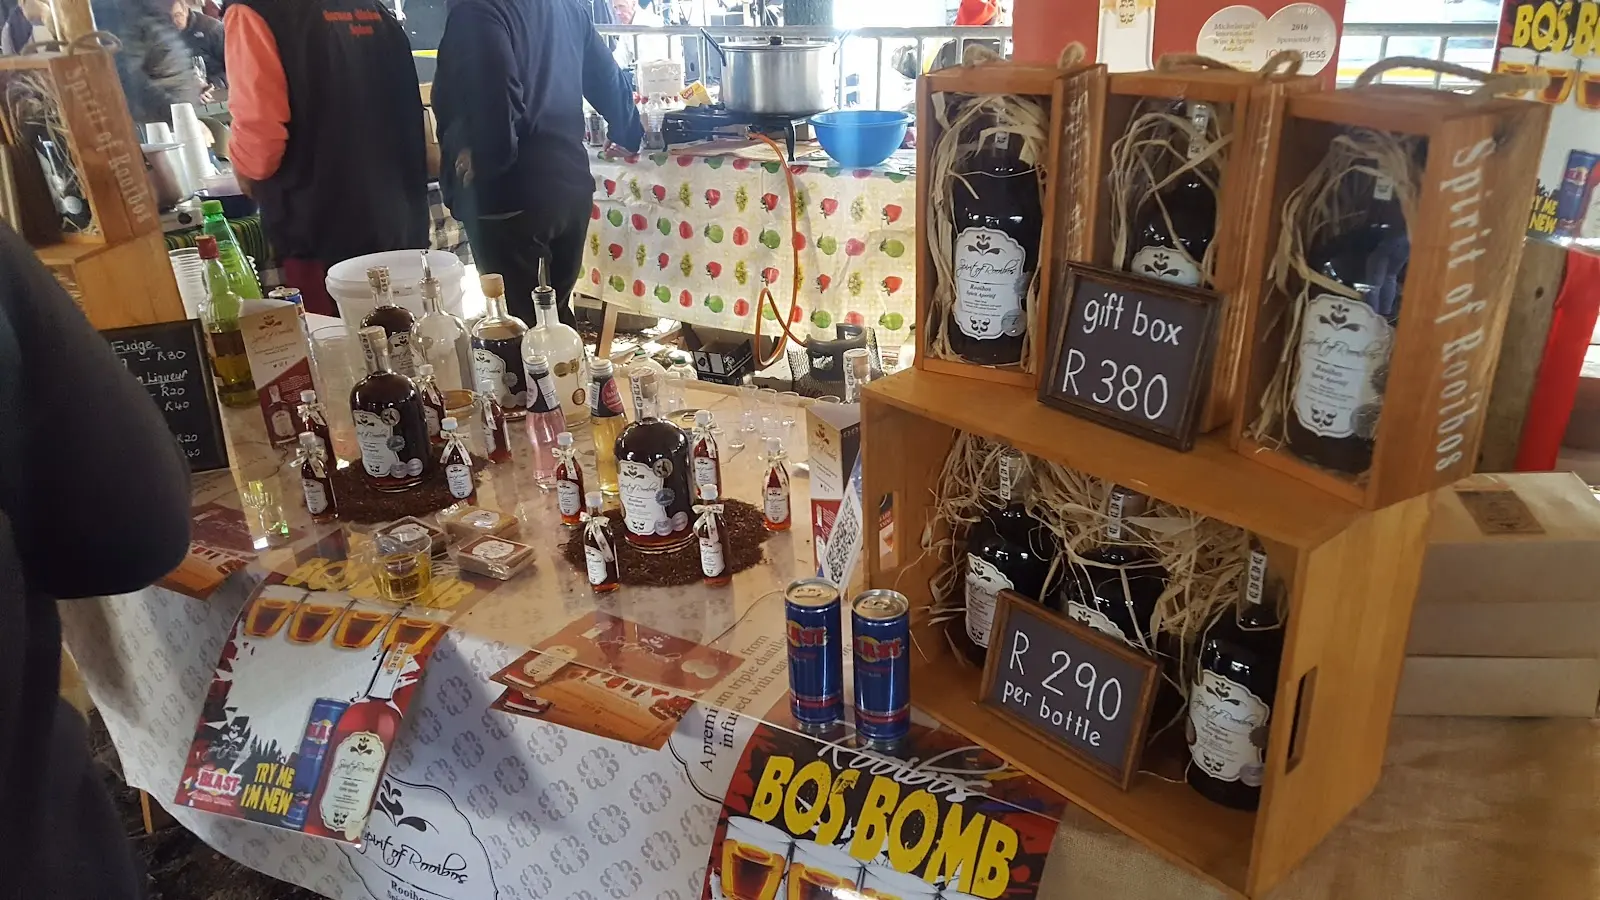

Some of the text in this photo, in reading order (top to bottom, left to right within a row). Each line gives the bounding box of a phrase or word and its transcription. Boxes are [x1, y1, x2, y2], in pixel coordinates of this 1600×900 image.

[1291, 23, 1309, 32] 2016
[1512, 3, 1574, 54] BOS
[1082, 292, 1183, 346] gift box
[1434, 136, 1497, 471] Spirit of Rooibos
[111, 340, 154, 355] Fudge
[147, 369, 188, 388] Liqueur
[1061, 348, 1169, 420] R 380
[741, 635, 770, 657] from
[1008, 630, 1122, 721] R 290
[700, 759, 714, 773] A
[727, 661, 759, 694] triple
[1002, 680, 1102, 747] per bottle
[240, 784, 263, 811] I'M
[259, 787, 294, 817] NEW
[254, 762, 296, 790] TRY ME
[749, 755, 1019, 900] BOS BOMB
[401, 844, 469, 883] Rooibos
